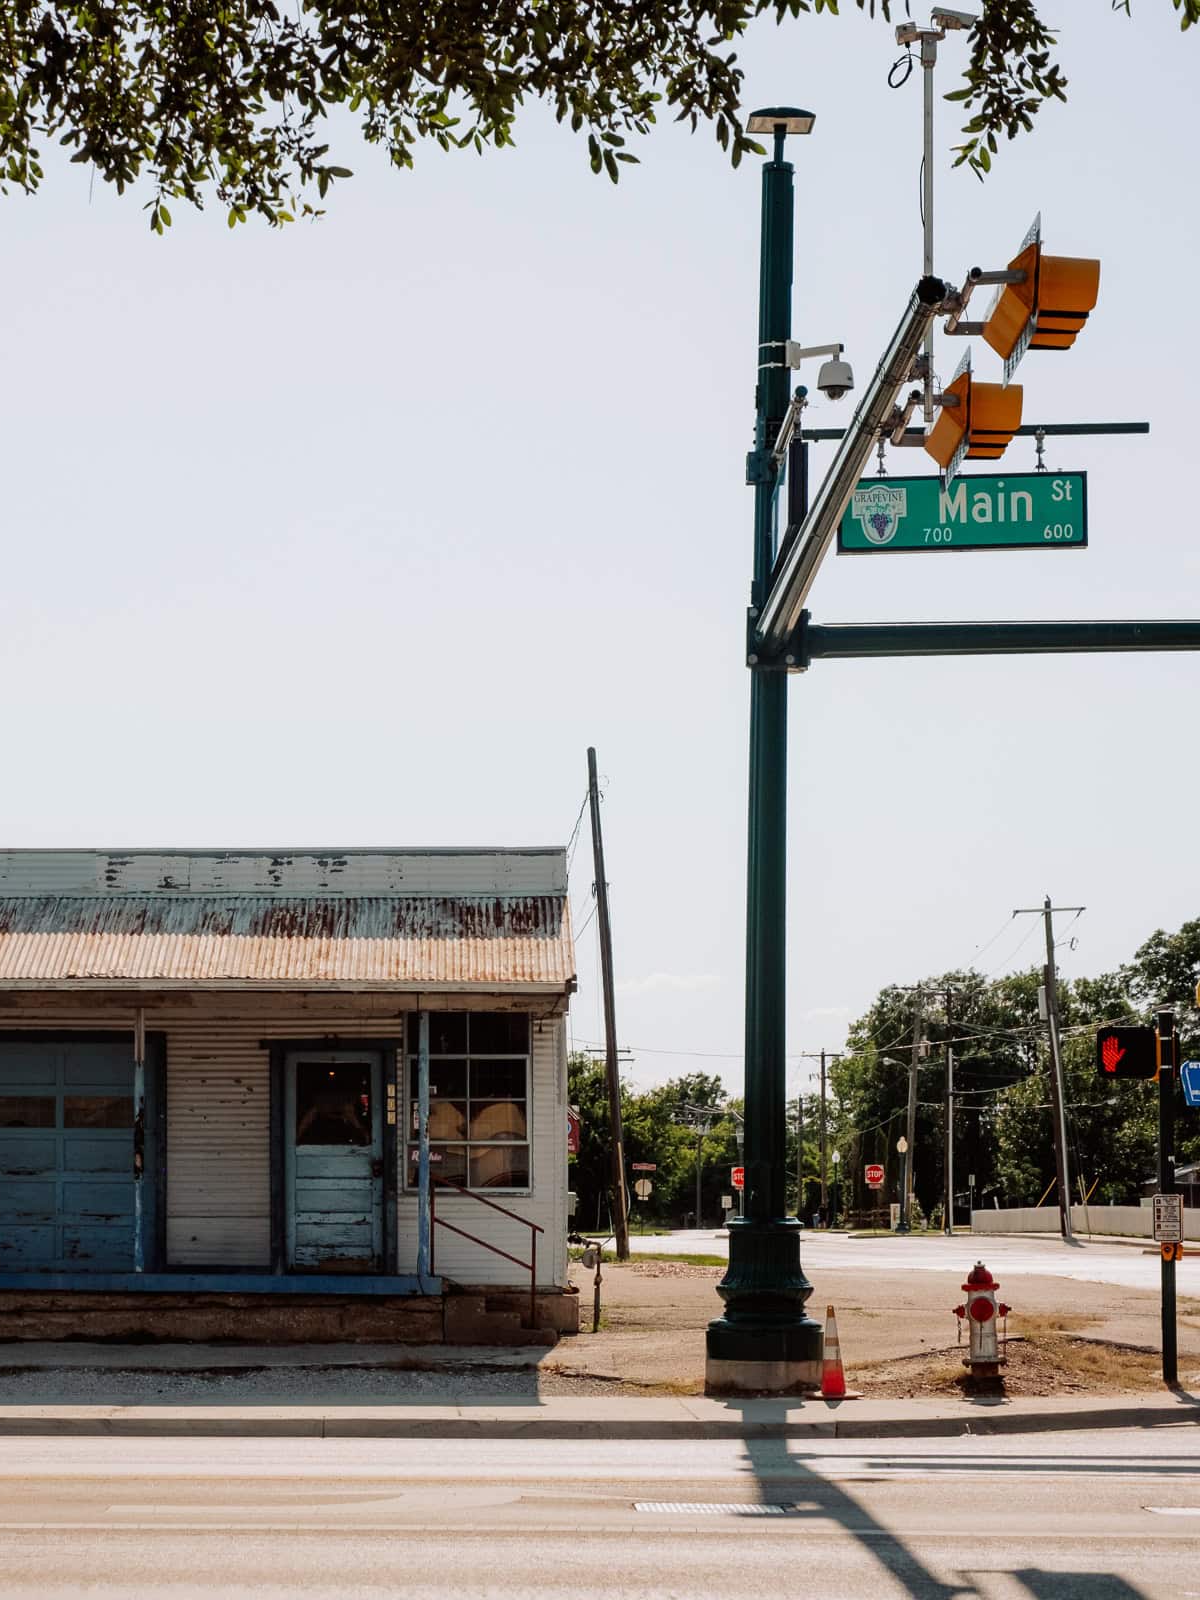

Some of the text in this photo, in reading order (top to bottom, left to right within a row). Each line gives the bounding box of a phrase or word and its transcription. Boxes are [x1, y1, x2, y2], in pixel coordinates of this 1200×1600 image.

[854, 492, 904, 503] GRAPEVINE
[939, 480, 1073, 524] Main St
[923, 527, 952, 543] 700
[1043, 523, 1073, 539] 600
[866, 1170, 883, 1178] STOP
